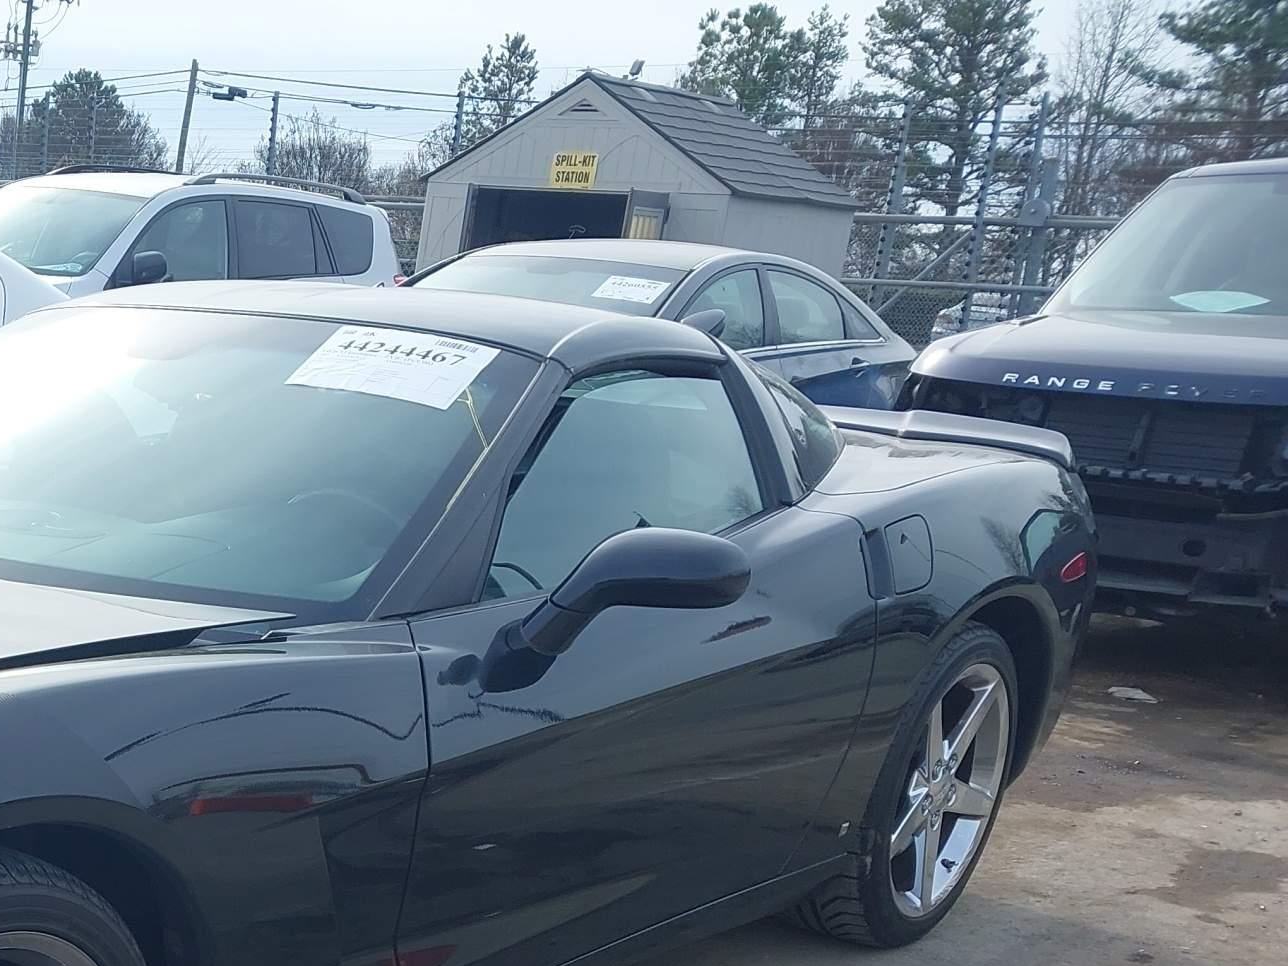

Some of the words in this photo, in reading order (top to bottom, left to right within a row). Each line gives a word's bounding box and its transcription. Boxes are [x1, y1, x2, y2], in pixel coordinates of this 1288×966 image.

[555, 154, 597, 167] SPILL-KIT
[555, 170, 591, 184] STATION
[338, 338, 466, 366] 44244467
[1002, 373, 1115, 391] RANGE
